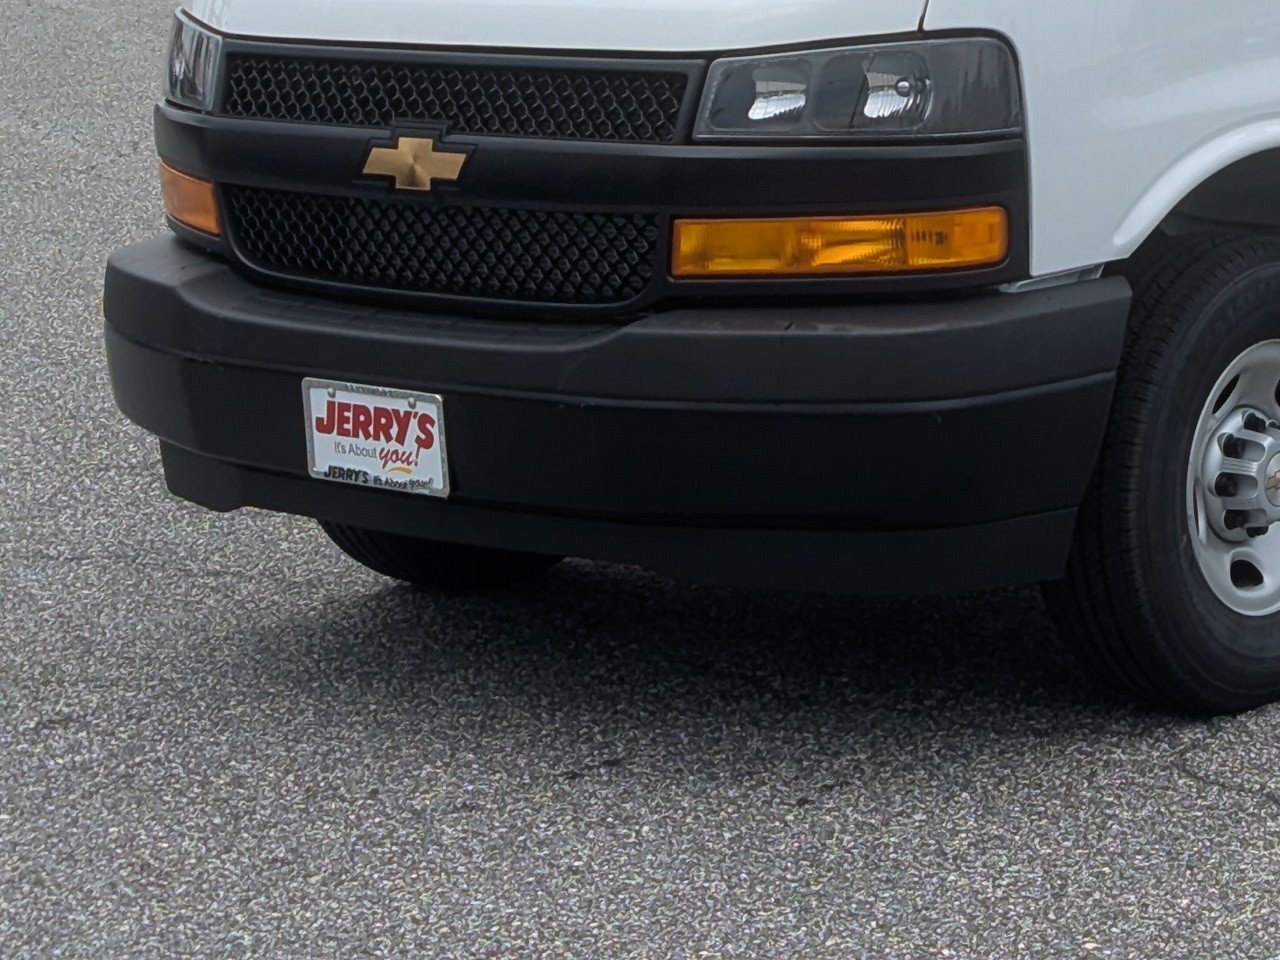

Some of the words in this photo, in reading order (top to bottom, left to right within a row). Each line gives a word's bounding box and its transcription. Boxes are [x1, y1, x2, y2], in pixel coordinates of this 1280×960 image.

[315, 400, 436, 450] JERRY'S
[334, 441, 346, 454] It's
[348, 442, 377, 458] About
